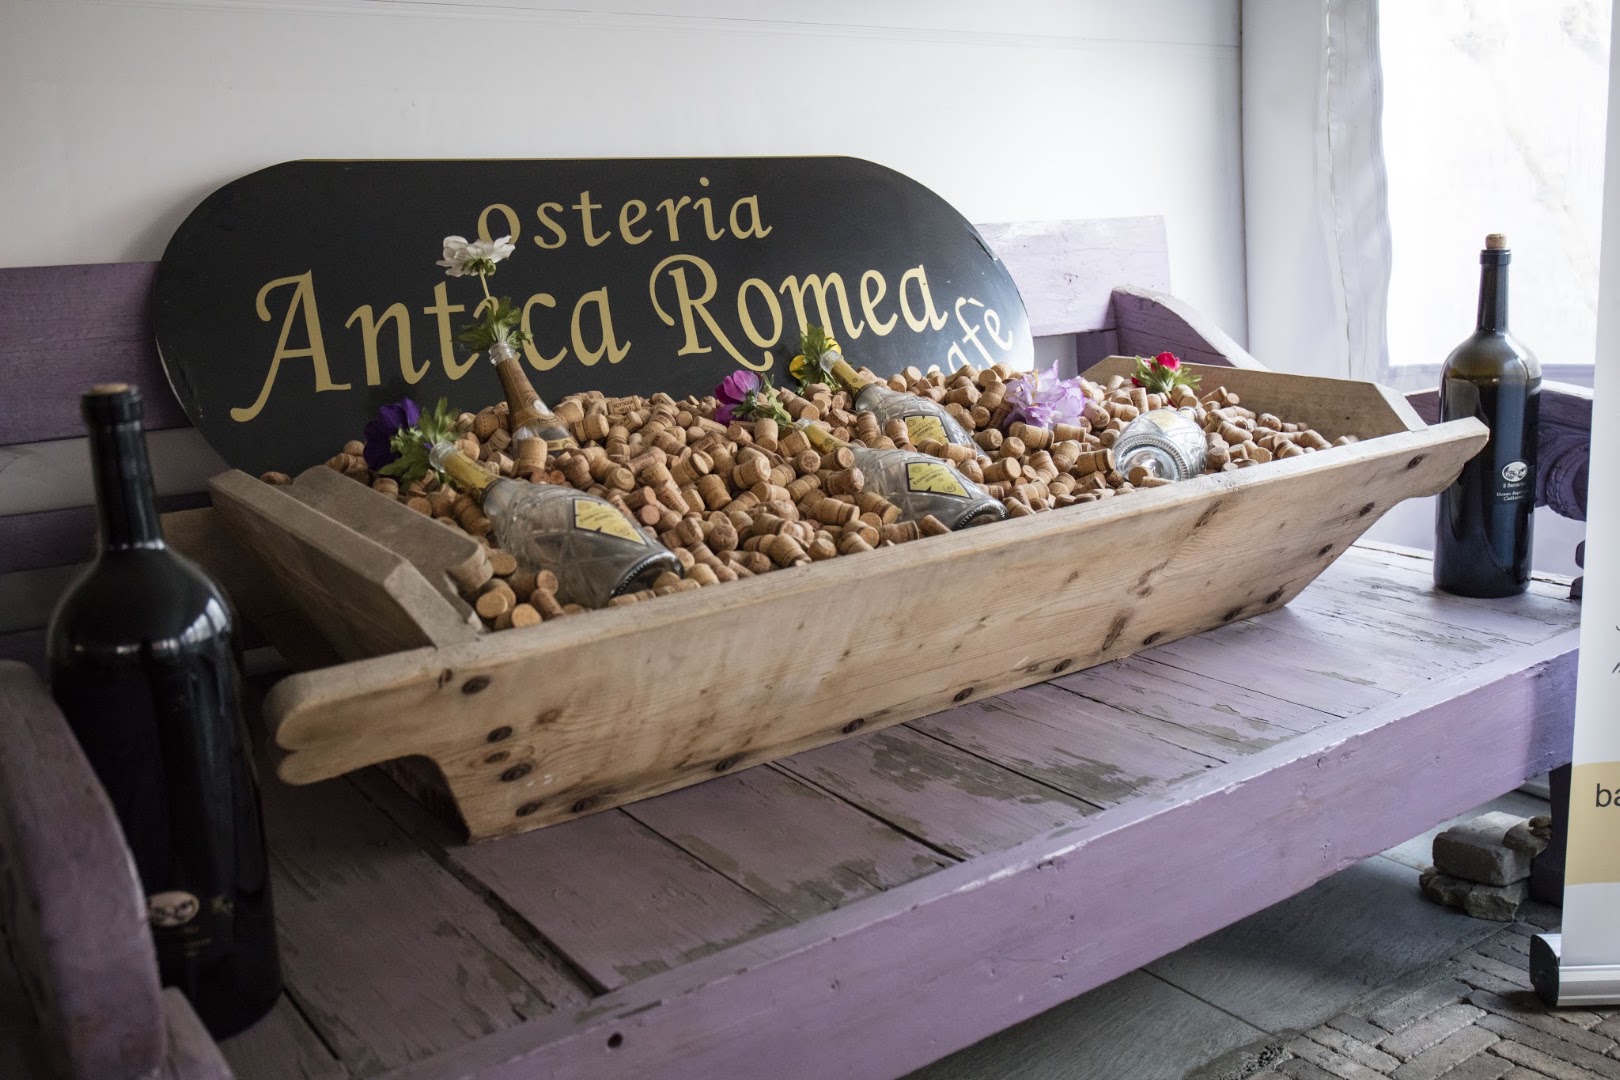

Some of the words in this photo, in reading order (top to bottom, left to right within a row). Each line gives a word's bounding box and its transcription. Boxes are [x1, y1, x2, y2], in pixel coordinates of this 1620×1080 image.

[476, 176, 773, 250] osteria
[648, 253, 949, 372] Romea
[927, 296, 1014, 374] afè
